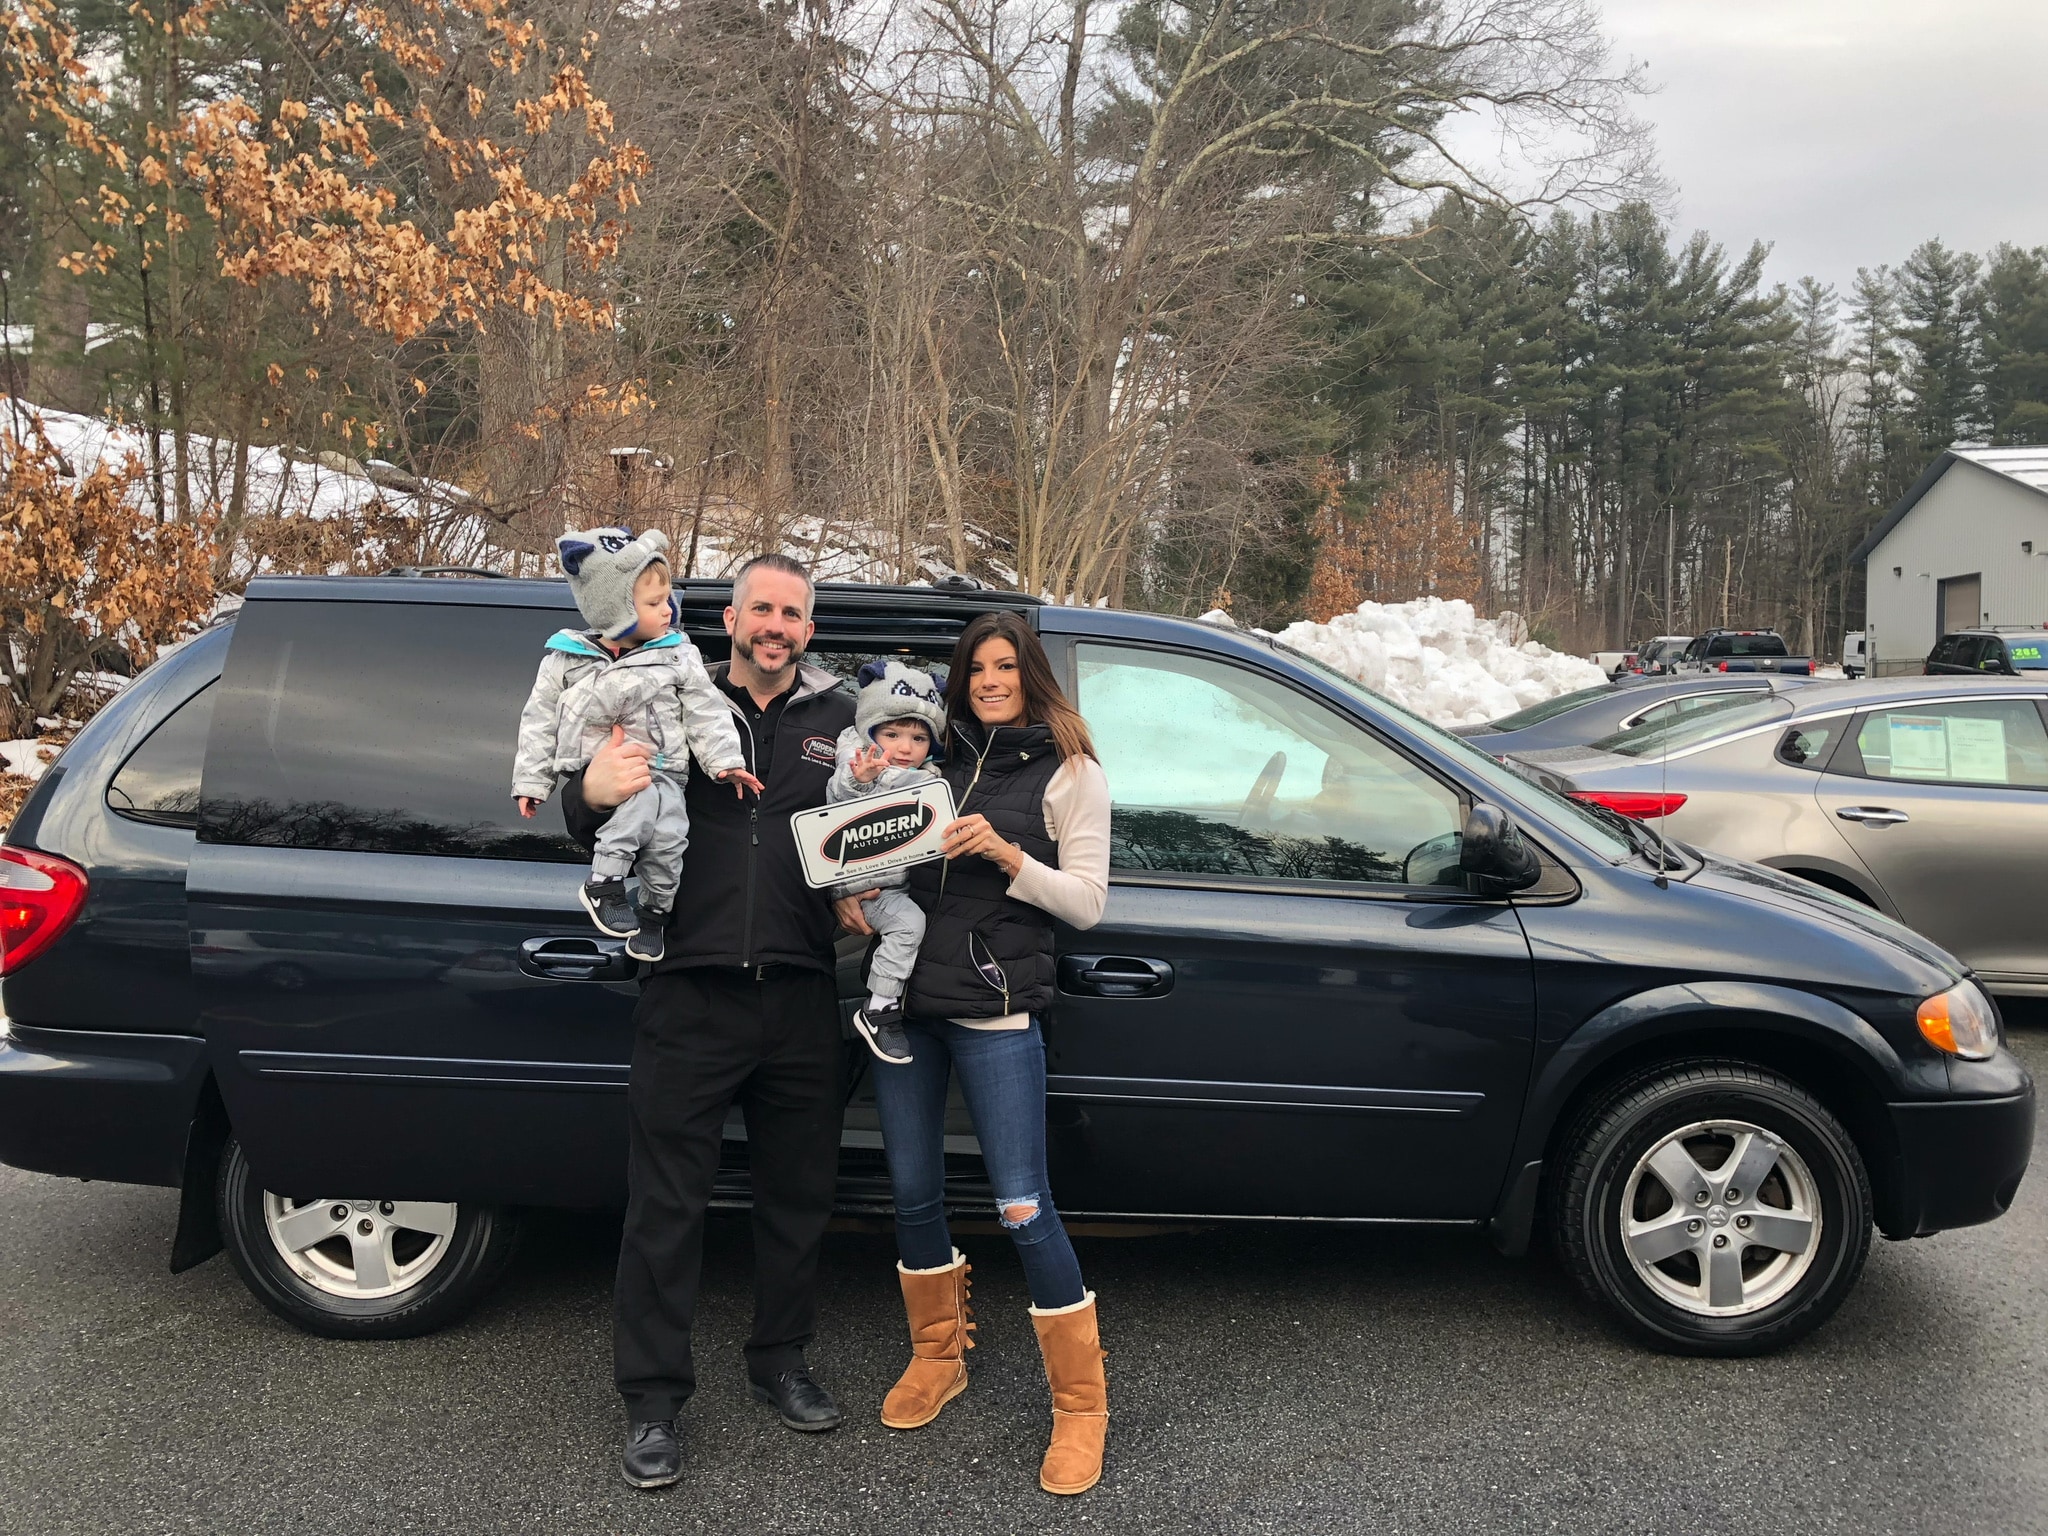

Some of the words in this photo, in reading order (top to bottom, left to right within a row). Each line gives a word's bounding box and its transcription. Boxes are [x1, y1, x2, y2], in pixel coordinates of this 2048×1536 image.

[853, 839, 879, 850] AUTO
[884, 830, 915, 842] SALES
[887, 857, 902, 865] Drive
